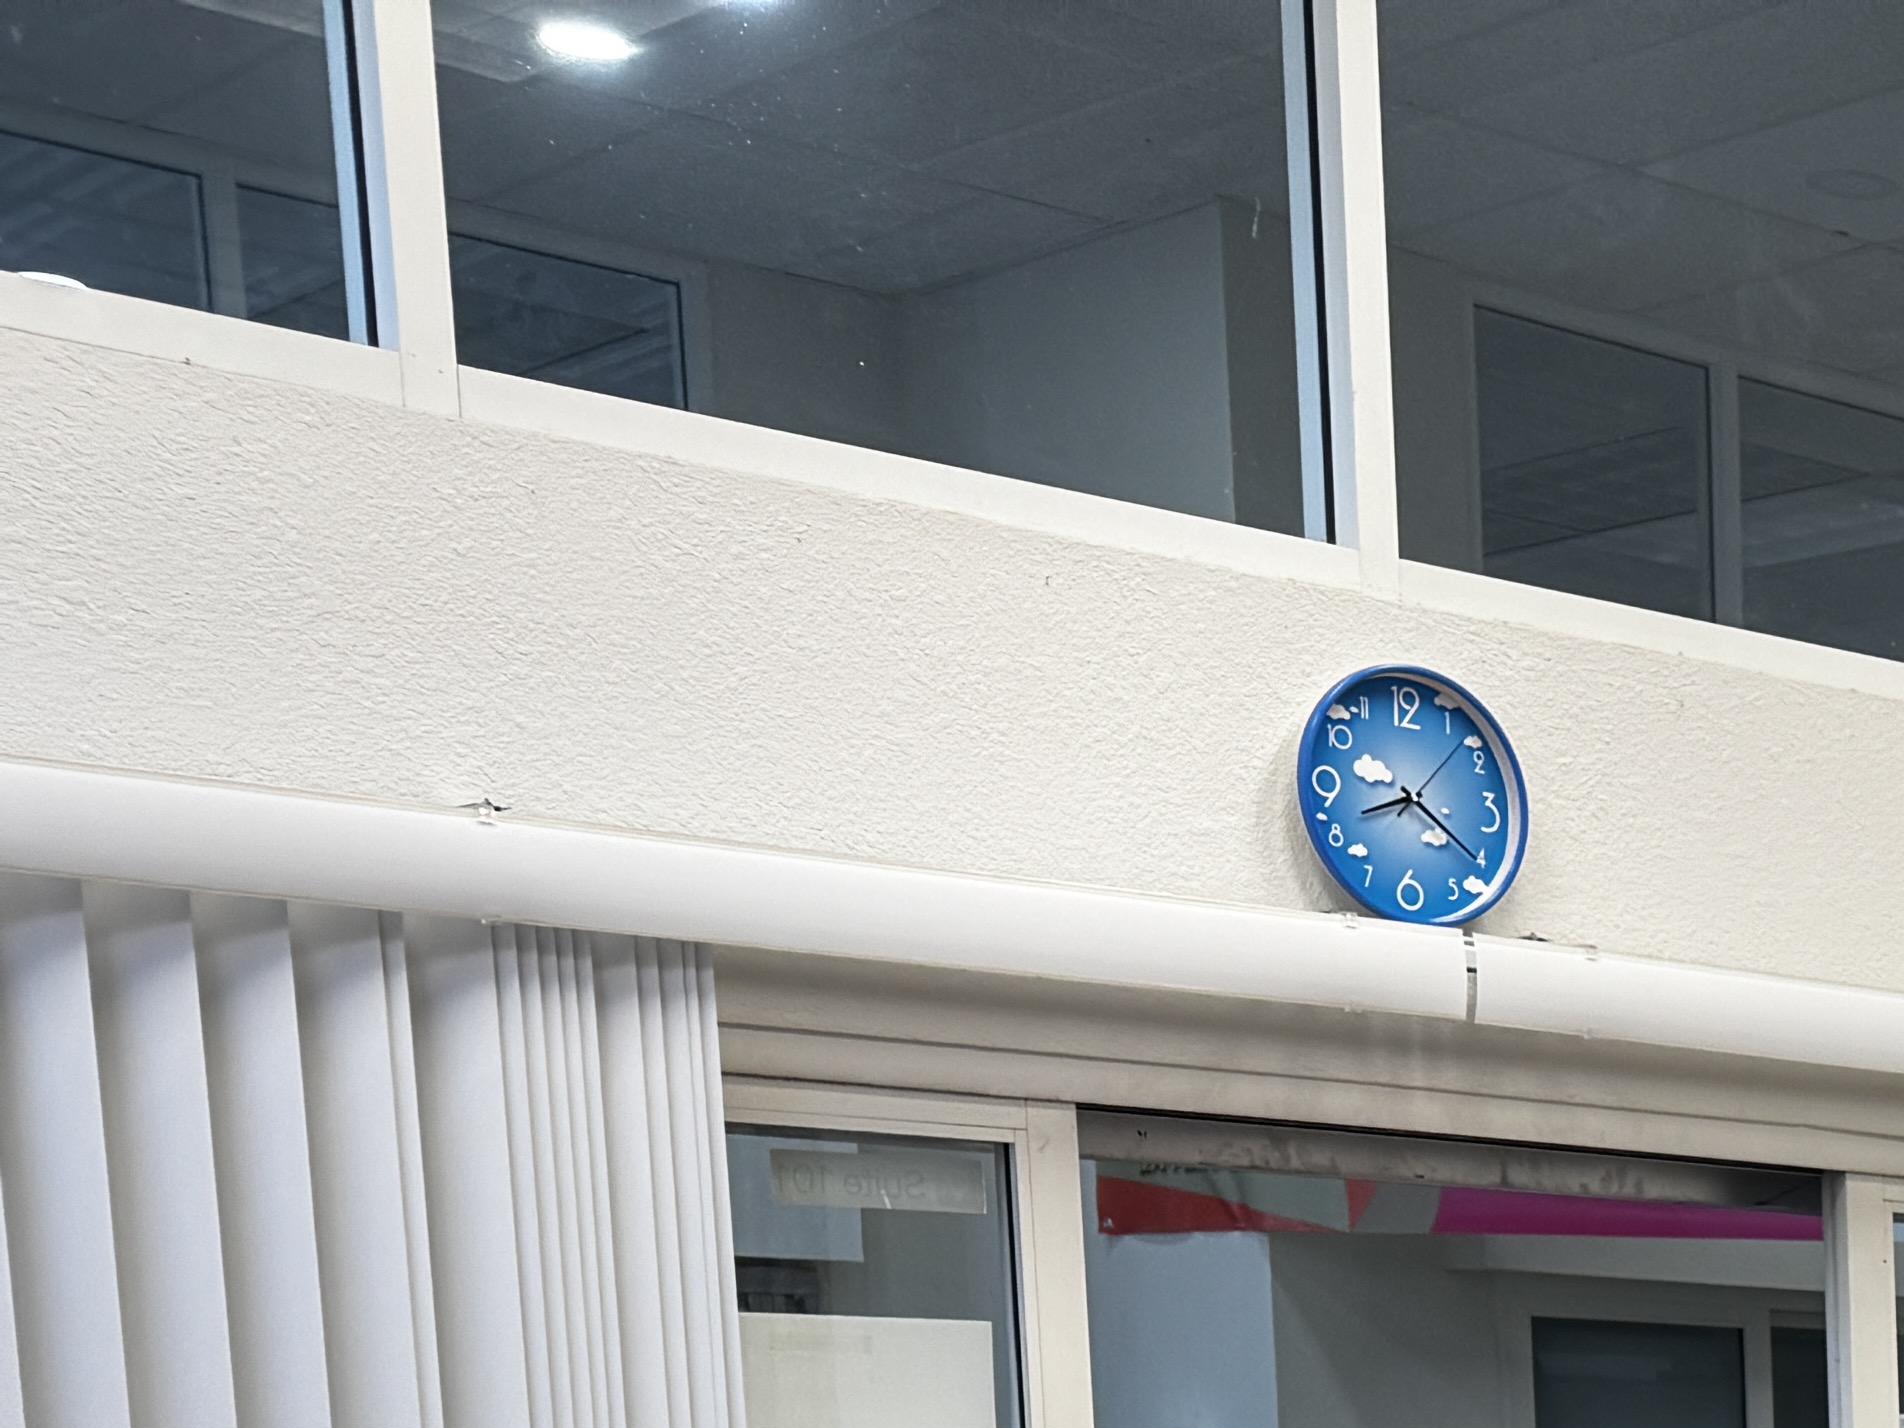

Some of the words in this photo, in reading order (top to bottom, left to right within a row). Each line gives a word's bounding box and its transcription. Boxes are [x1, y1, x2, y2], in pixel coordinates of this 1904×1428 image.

[1359, 696, 1369, 719] 11
[1391, 685, 1420, 730] 12
[1445, 712, 1450, 734] 1
[1327, 724, 1352, 749] 10
[1474, 751, 1485, 774] 2
[1312, 765, 1341, 807] 9
[1480, 792, 1500, 833] 3
[1329, 824, 1343, 847] 8
[1476, 849, 1486, 868] 4
[1363, 865, 1373, 887] 7
[1396, 869, 1424, 911] 6
[1448, 878, 1459, 900] 5
